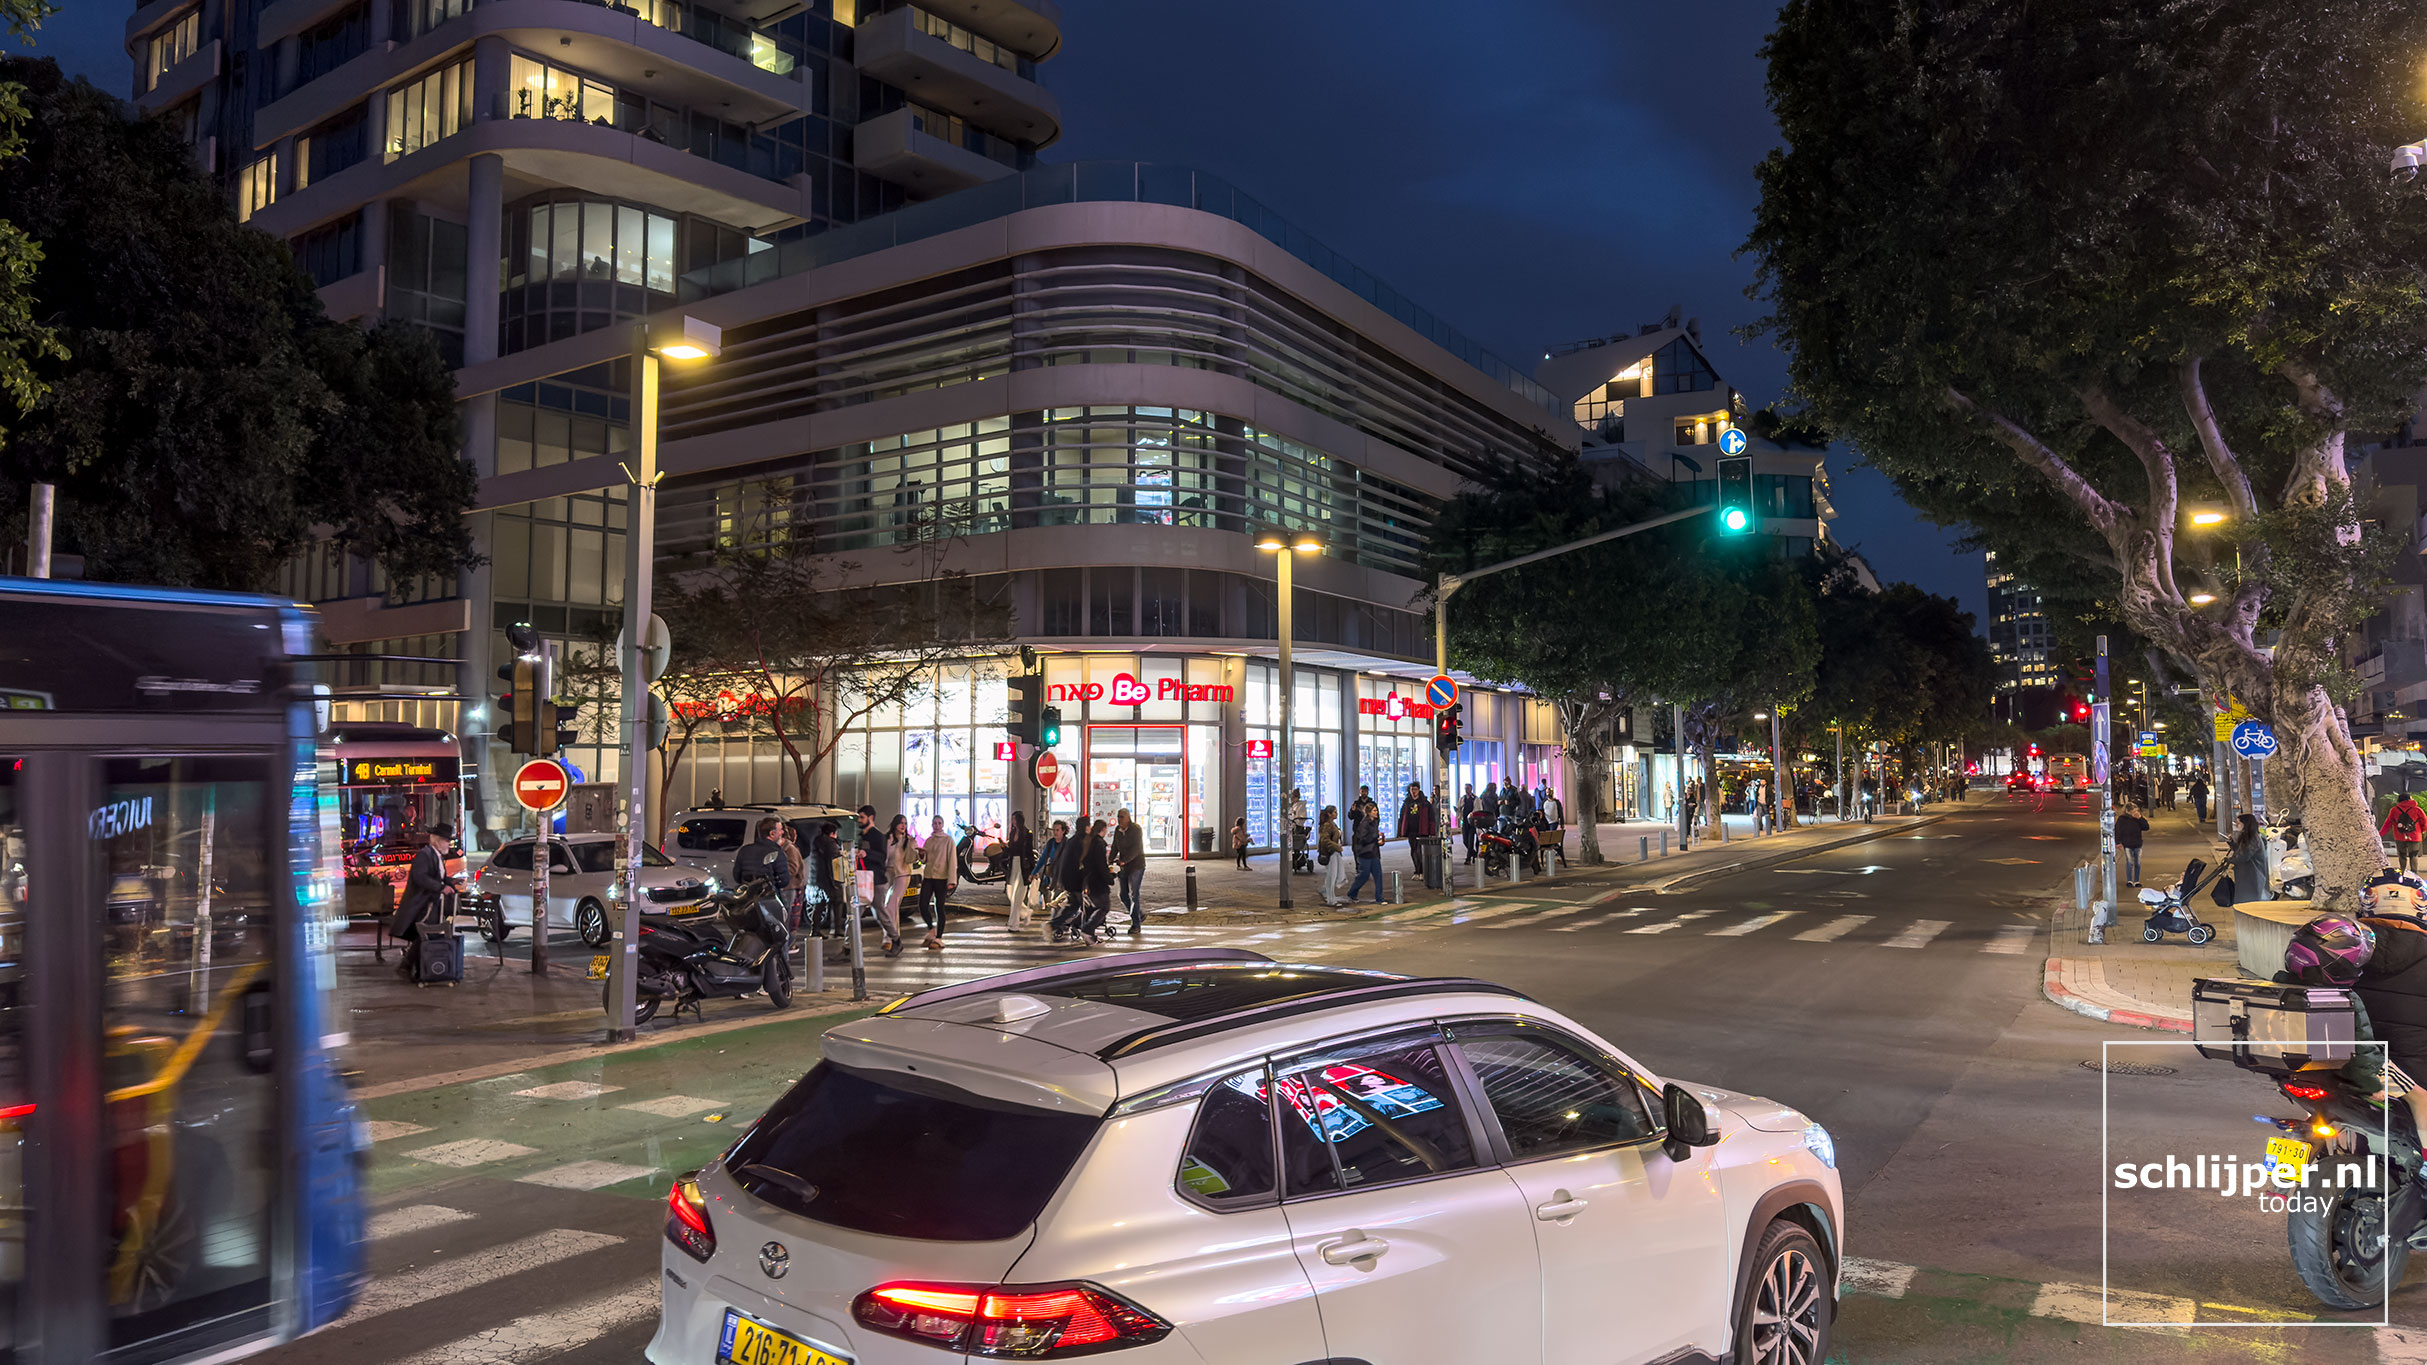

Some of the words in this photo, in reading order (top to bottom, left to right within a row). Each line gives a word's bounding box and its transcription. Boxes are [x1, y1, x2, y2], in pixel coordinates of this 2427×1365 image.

[1047, 683, 1104, 702] פאר
[1114, 679, 1147, 702] Be
[1158, 678, 1234, 703] Pharm
